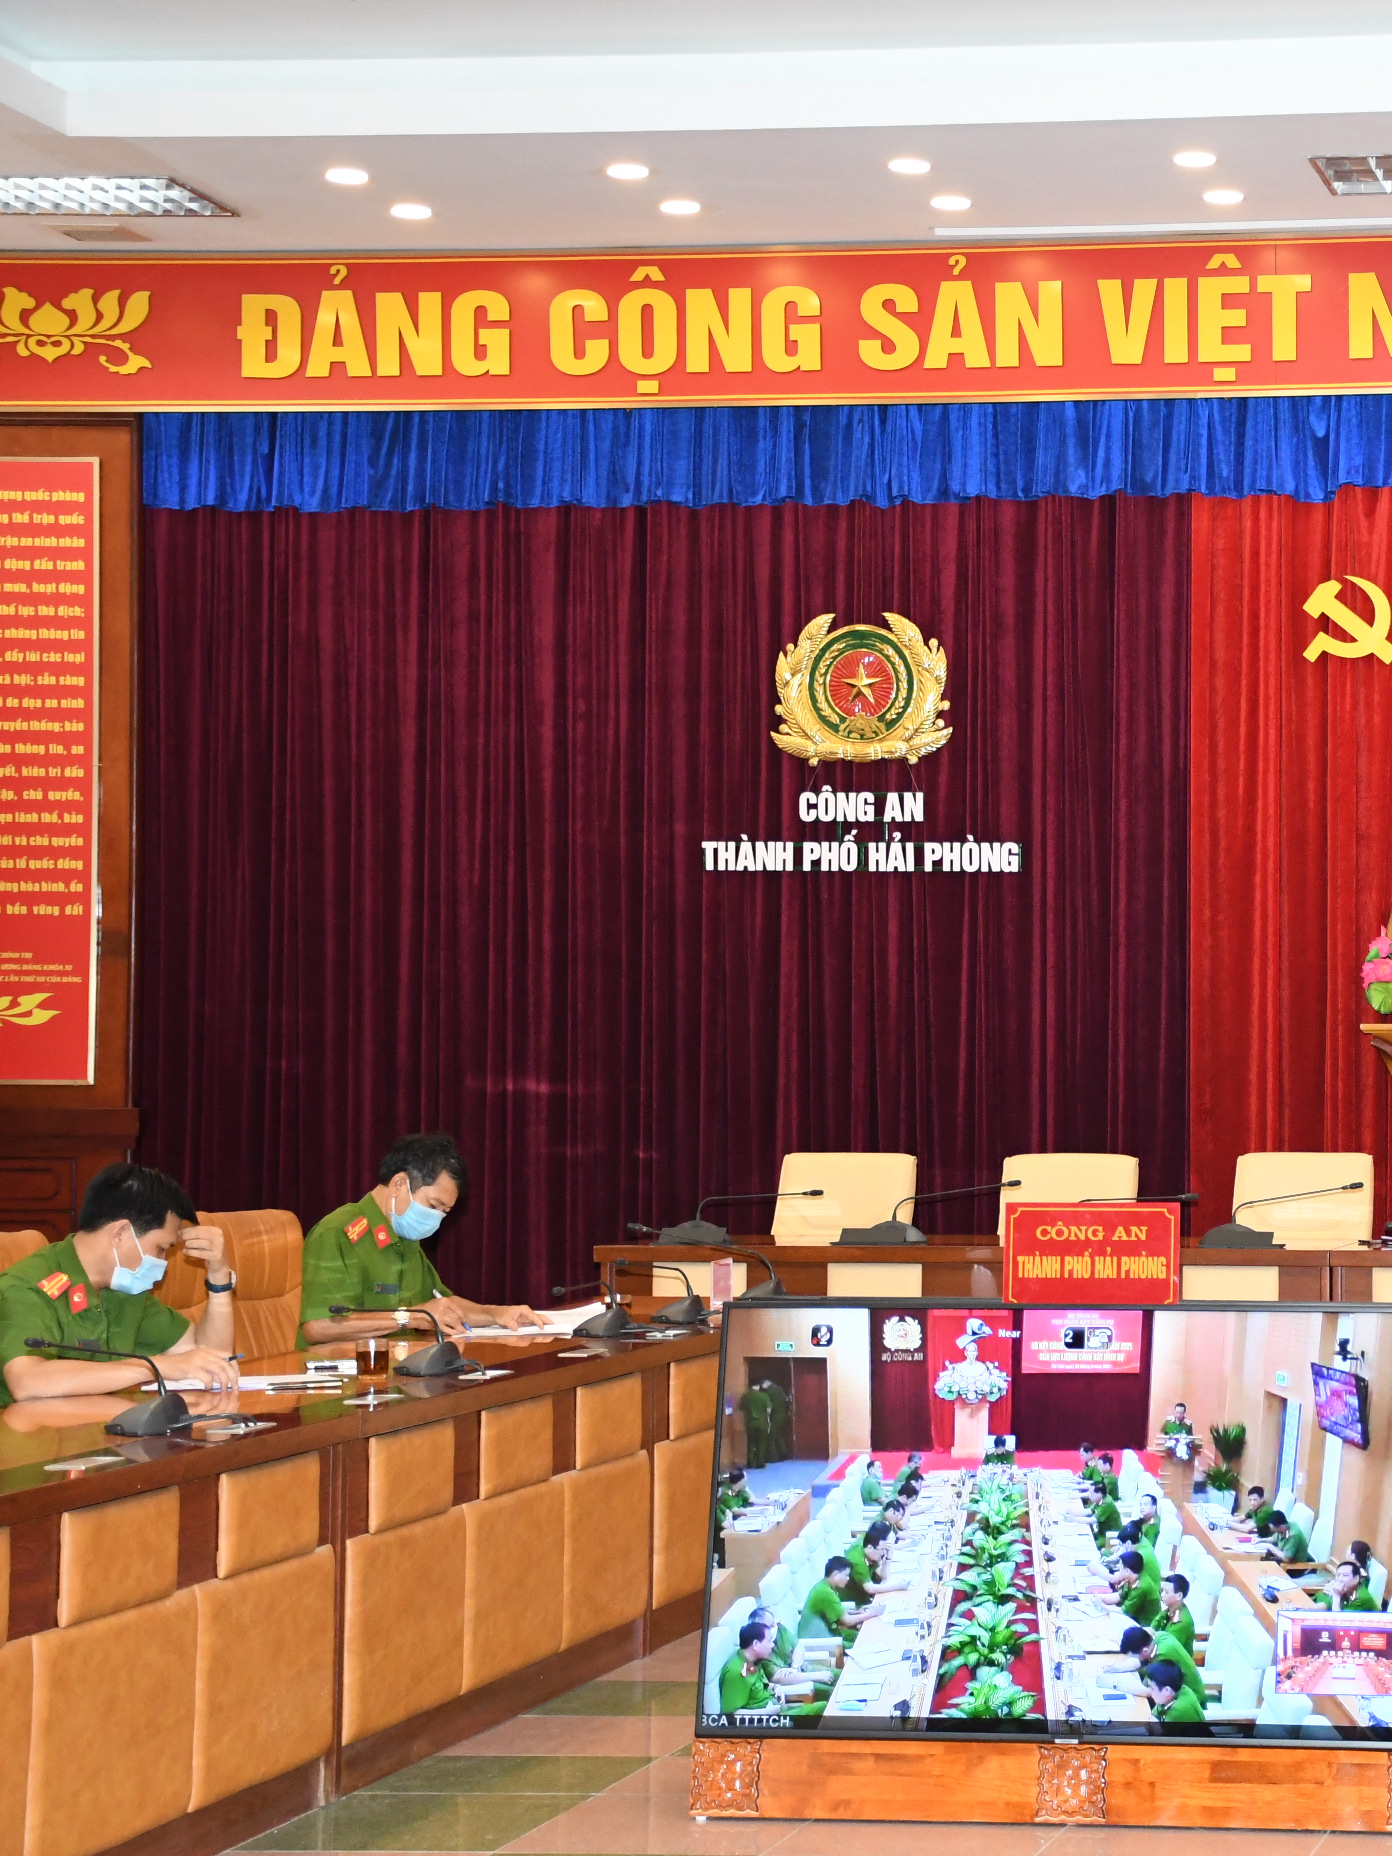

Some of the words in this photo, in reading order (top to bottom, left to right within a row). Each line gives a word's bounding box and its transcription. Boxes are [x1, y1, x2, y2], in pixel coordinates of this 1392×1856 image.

[237, 264, 511, 379] ĐẢNG
[549, 265, 822, 394] CỘNG
[857, 254, 1064, 371] SẢN
[1096, 253, 1312, 382] VIỆT
[799, 785, 875, 823] CÔNG
[883, 792, 924, 823] AN
[702, 834, 794, 872] THÀNH
[802, 829, 858, 872] PHỐ
[868, 832, 915, 872] HẢI
[924, 835, 1021, 872] PHÒNG
[1036, 1221, 1105, 1241] CÔNG
[1112, 1225, 1148, 1241] AN
[1017, 1251, 1061, 1279] THÀNH
[1065, 1248, 1092, 1279] PHỐ
[1095, 1247, 1117, 1279] HẢI
[1121, 1250, 1167, 1279] PHÒNG
[998, 1329, 1021, 1338] Near
[1064, 1330, 1074, 1343] 2
[734, 1714, 790, 1728] TTTTCH
